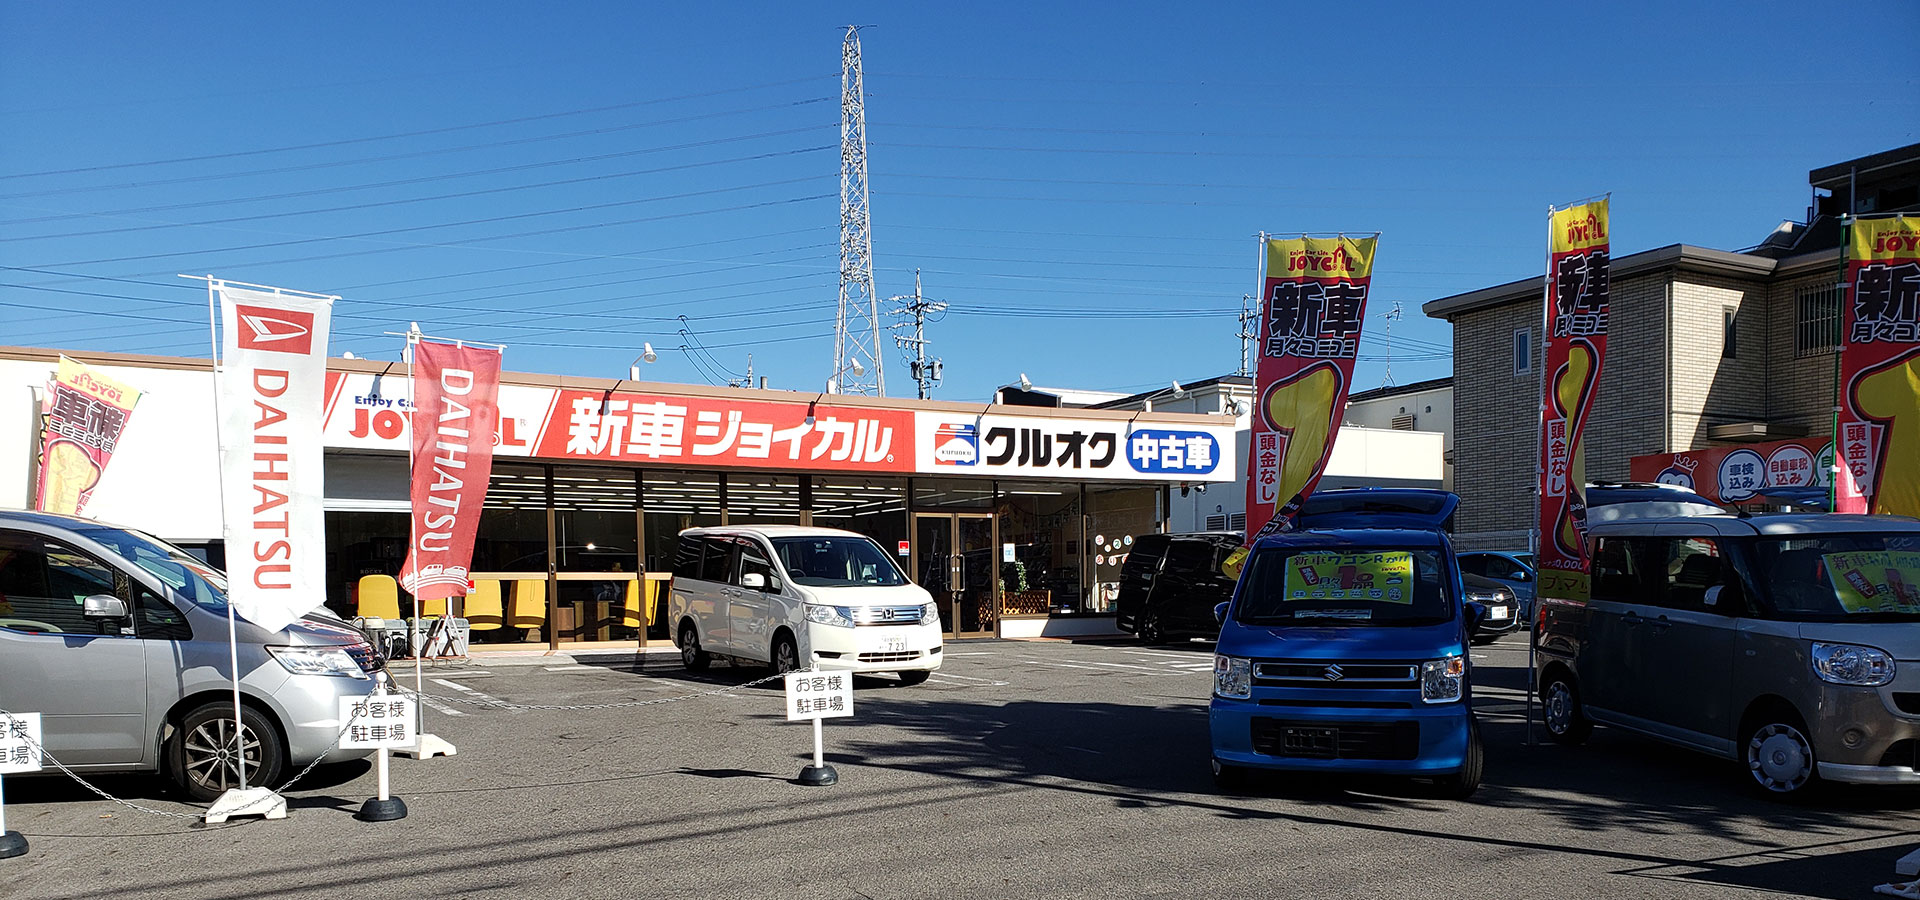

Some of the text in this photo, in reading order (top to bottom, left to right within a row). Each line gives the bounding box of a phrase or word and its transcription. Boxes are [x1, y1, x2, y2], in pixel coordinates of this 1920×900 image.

[1873, 236, 1920, 253] JOY
[1288, 244, 1356, 272] JOYCAL
[1268, 282, 1367, 339] 新車
[1850, 321, 1920, 342] 月々コ
[1265, 336, 1356, 359] 月々コミコミ
[354, 395, 392, 408] Enjoy
[349, 404, 527, 446] JOL
[984, 426, 1212, 470] クルオク 中古車
[1551, 421, 1566, 495] 頭金なし
[419, 367, 475, 552] DAIHATSU
[1259, 433, 1277, 502] 頭金なし
[1729, 462, 1754, 476] 車検
[1770, 456, 1808, 473] 自動車税
[1847, 423, 1868, 495] 頭金なし
[253, 368, 292, 590] DAIHATSU
[1729, 476, 1755, 490] 込み
[1775, 472, 1803, 486] 込み
[795, 675, 843, 692] お客様
[351, 701, 405, 718] お客様
[796, 695, 844, 714] 駐車場
[350, 723, 405, 742] 駐車場
